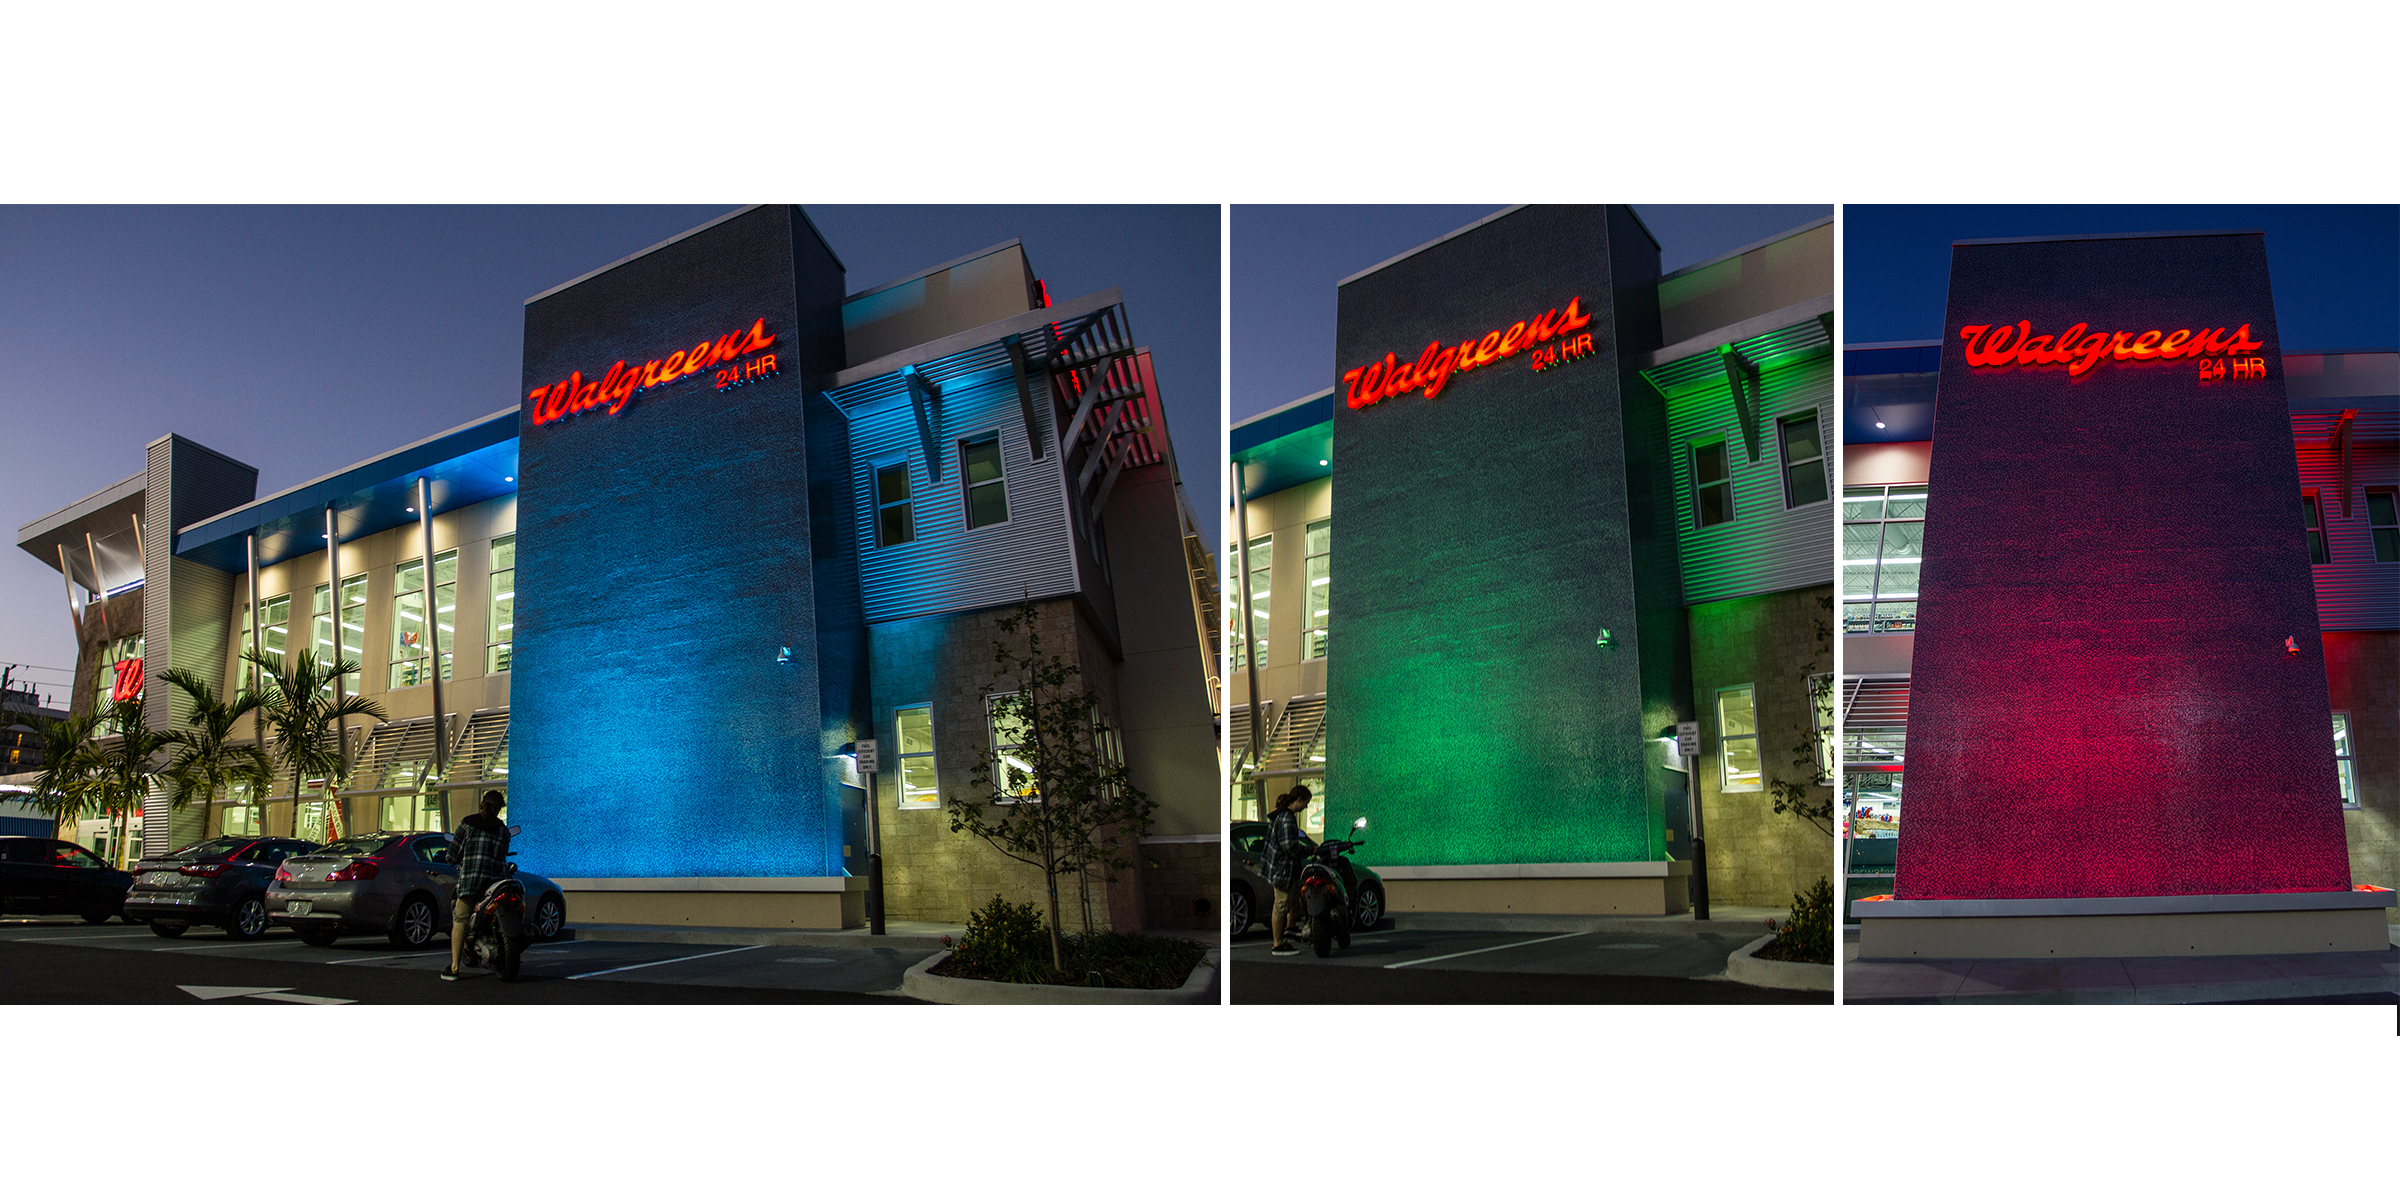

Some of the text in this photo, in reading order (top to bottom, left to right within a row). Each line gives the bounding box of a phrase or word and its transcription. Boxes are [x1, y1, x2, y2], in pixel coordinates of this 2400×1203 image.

[528, 317, 776, 426] Walgreens
[715, 354, 777, 389] 24 HR
[1342, 295, 1592, 410] Walgreens
[1532, 333, 1594, 370] 24 HR
[1960, 319, 2265, 377] Walgreens
[2199, 357, 2267, 380] 24 HR
